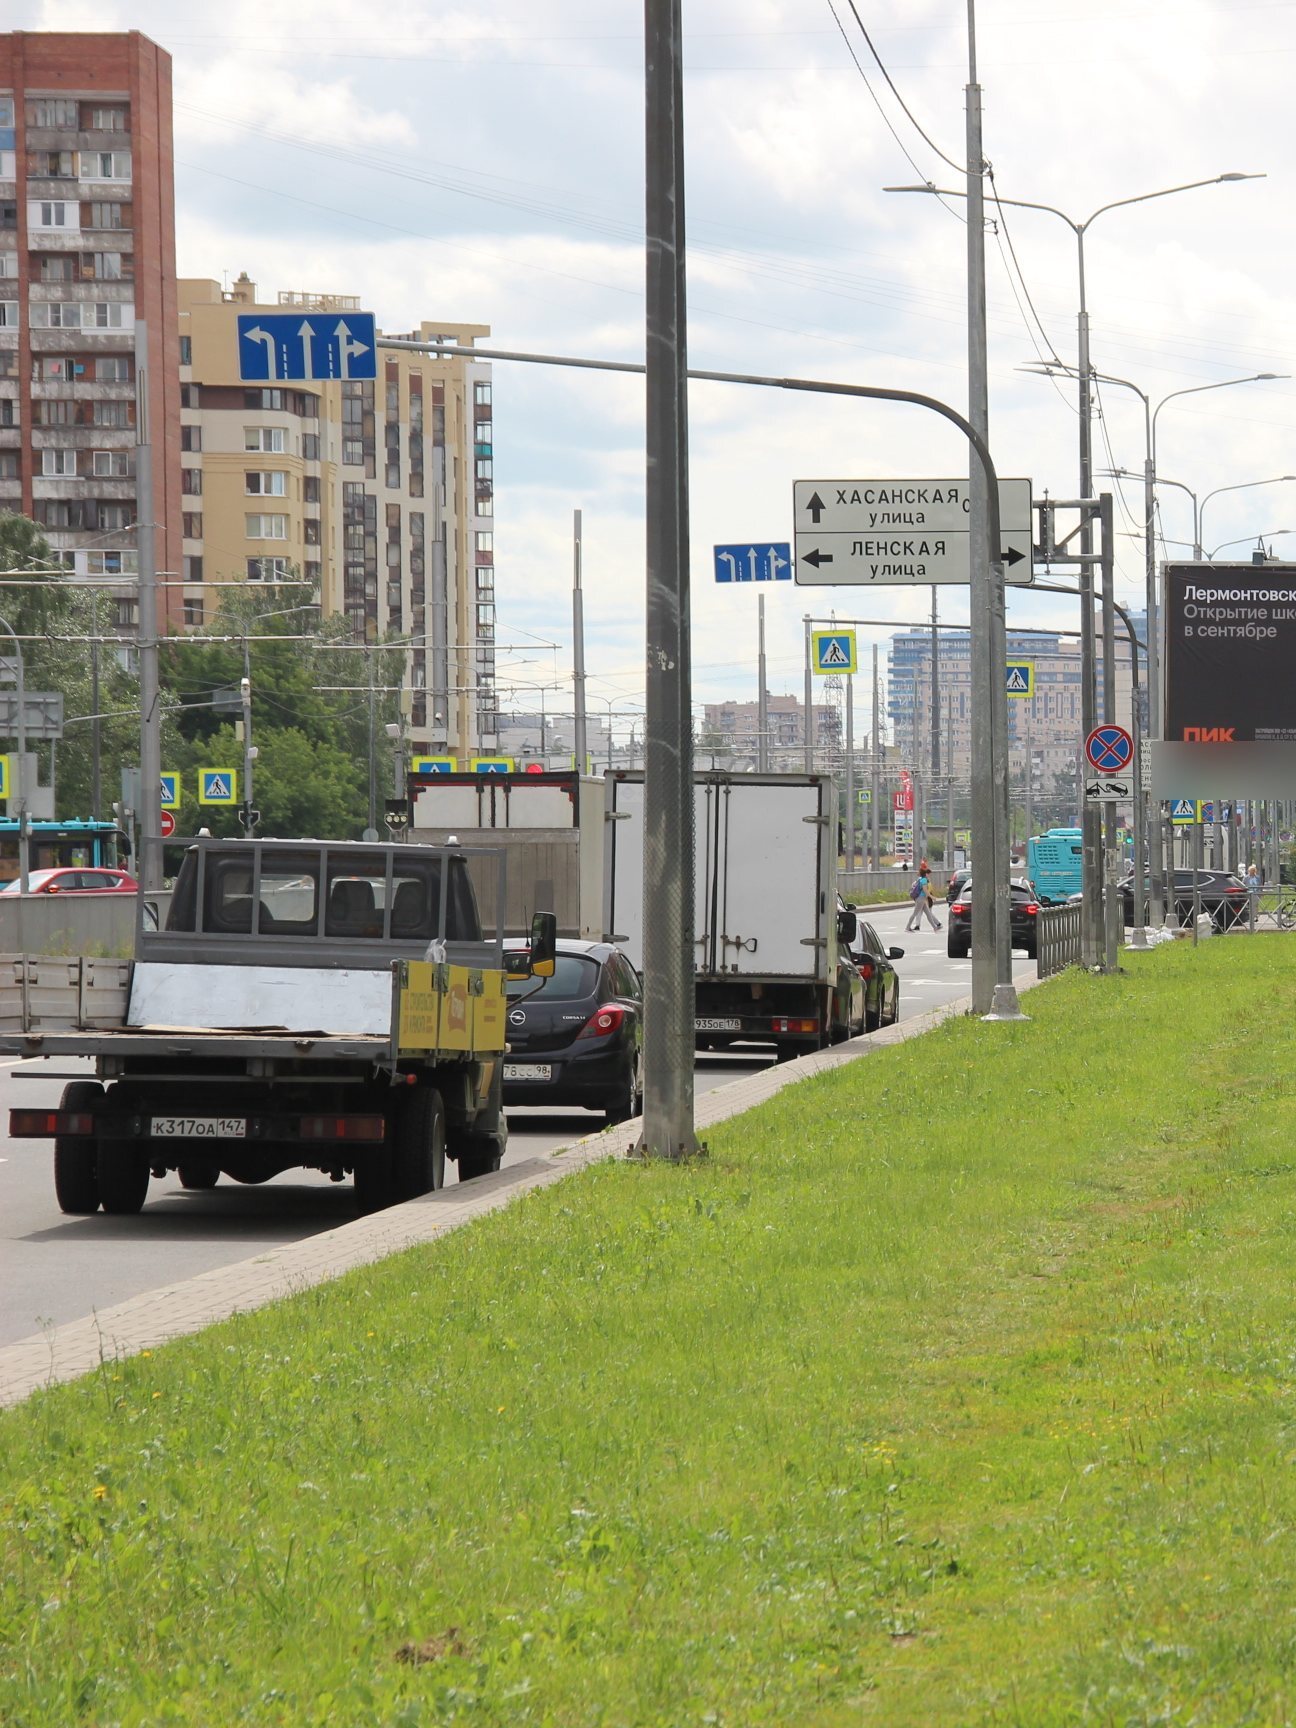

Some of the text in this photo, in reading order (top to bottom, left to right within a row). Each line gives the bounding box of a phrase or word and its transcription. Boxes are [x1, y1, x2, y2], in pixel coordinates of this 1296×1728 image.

[835, 488, 959, 505] ХАСАНСКАЯ
[869, 510, 925, 528] улица
[850, 540, 946, 556] ЛЕНСКАЯ
[870, 562, 926, 579] улица
[1183, 604, 1268, 622] Открытие
[1184, 622, 1278, 641] в сентябре
[1183, 727, 1236, 742] ПИК
[695, 1019, 724, 1029] 935ОЕ
[155, 1120, 242, 1135] К317ОА 147
